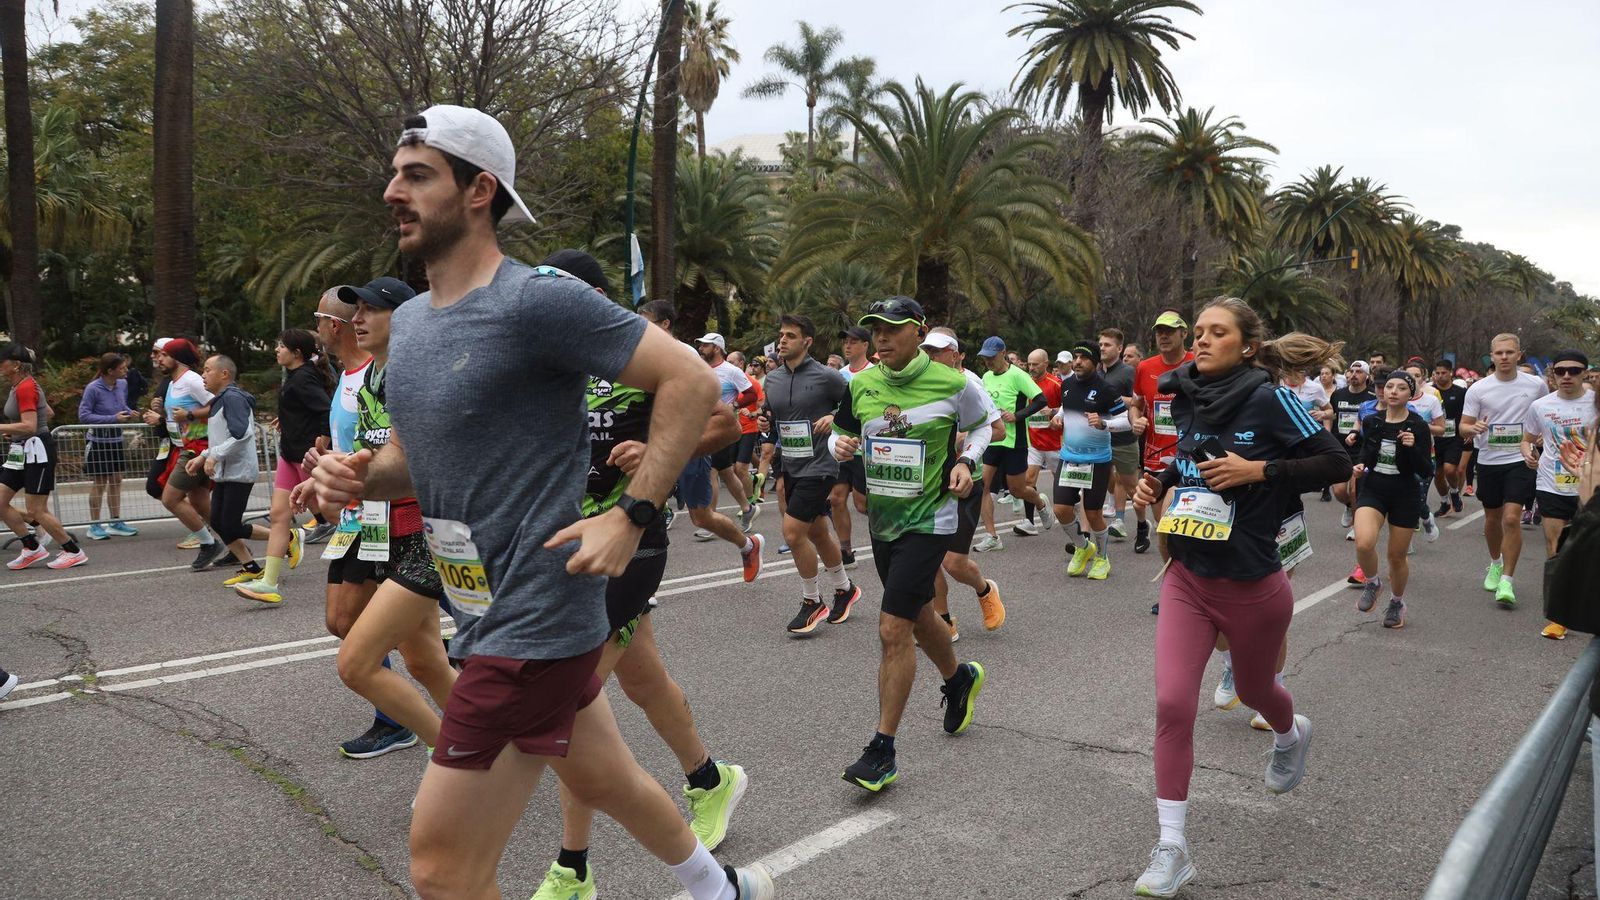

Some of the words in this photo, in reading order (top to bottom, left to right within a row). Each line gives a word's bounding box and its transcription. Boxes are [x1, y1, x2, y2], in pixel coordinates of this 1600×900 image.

[783, 437, 805, 447] 4123
[876, 465, 912, 481] 4180
[1170, 518, 1215, 538] 3170
